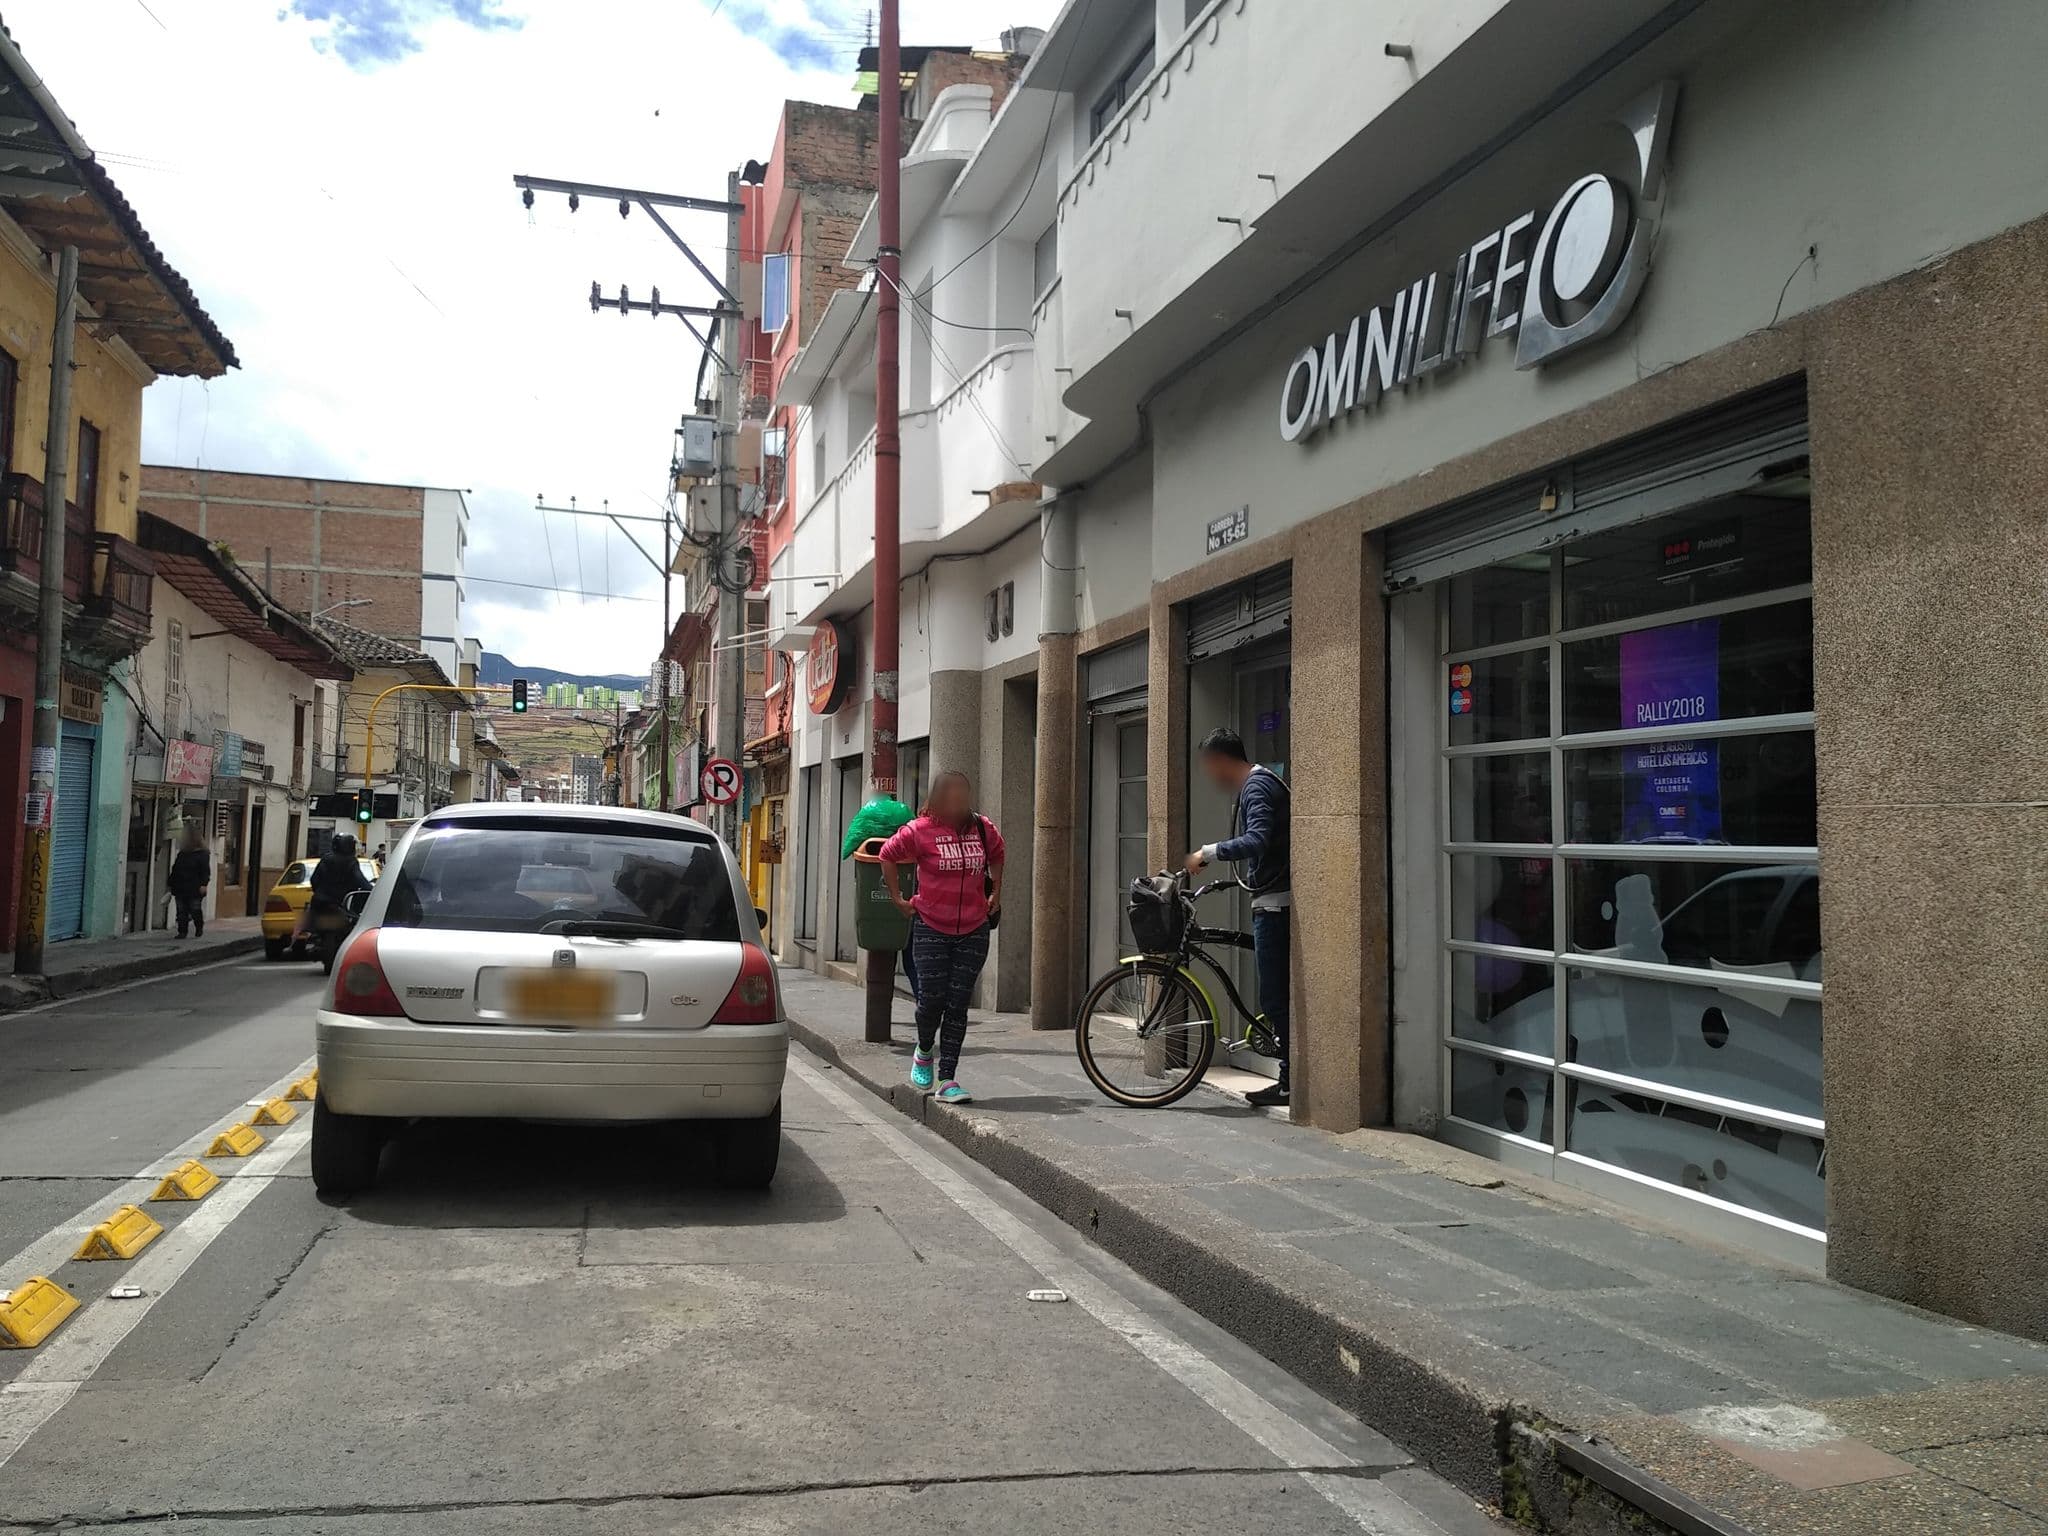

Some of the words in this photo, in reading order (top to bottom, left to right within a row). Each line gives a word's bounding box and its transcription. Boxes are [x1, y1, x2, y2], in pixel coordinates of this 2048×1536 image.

[1280, 209, 1535, 442] OMNILIFE
[1222, 522, 1246, 545] 15-62
[936, 835, 953, 843] NEW
[936, 841, 984, 859] YANKEES
